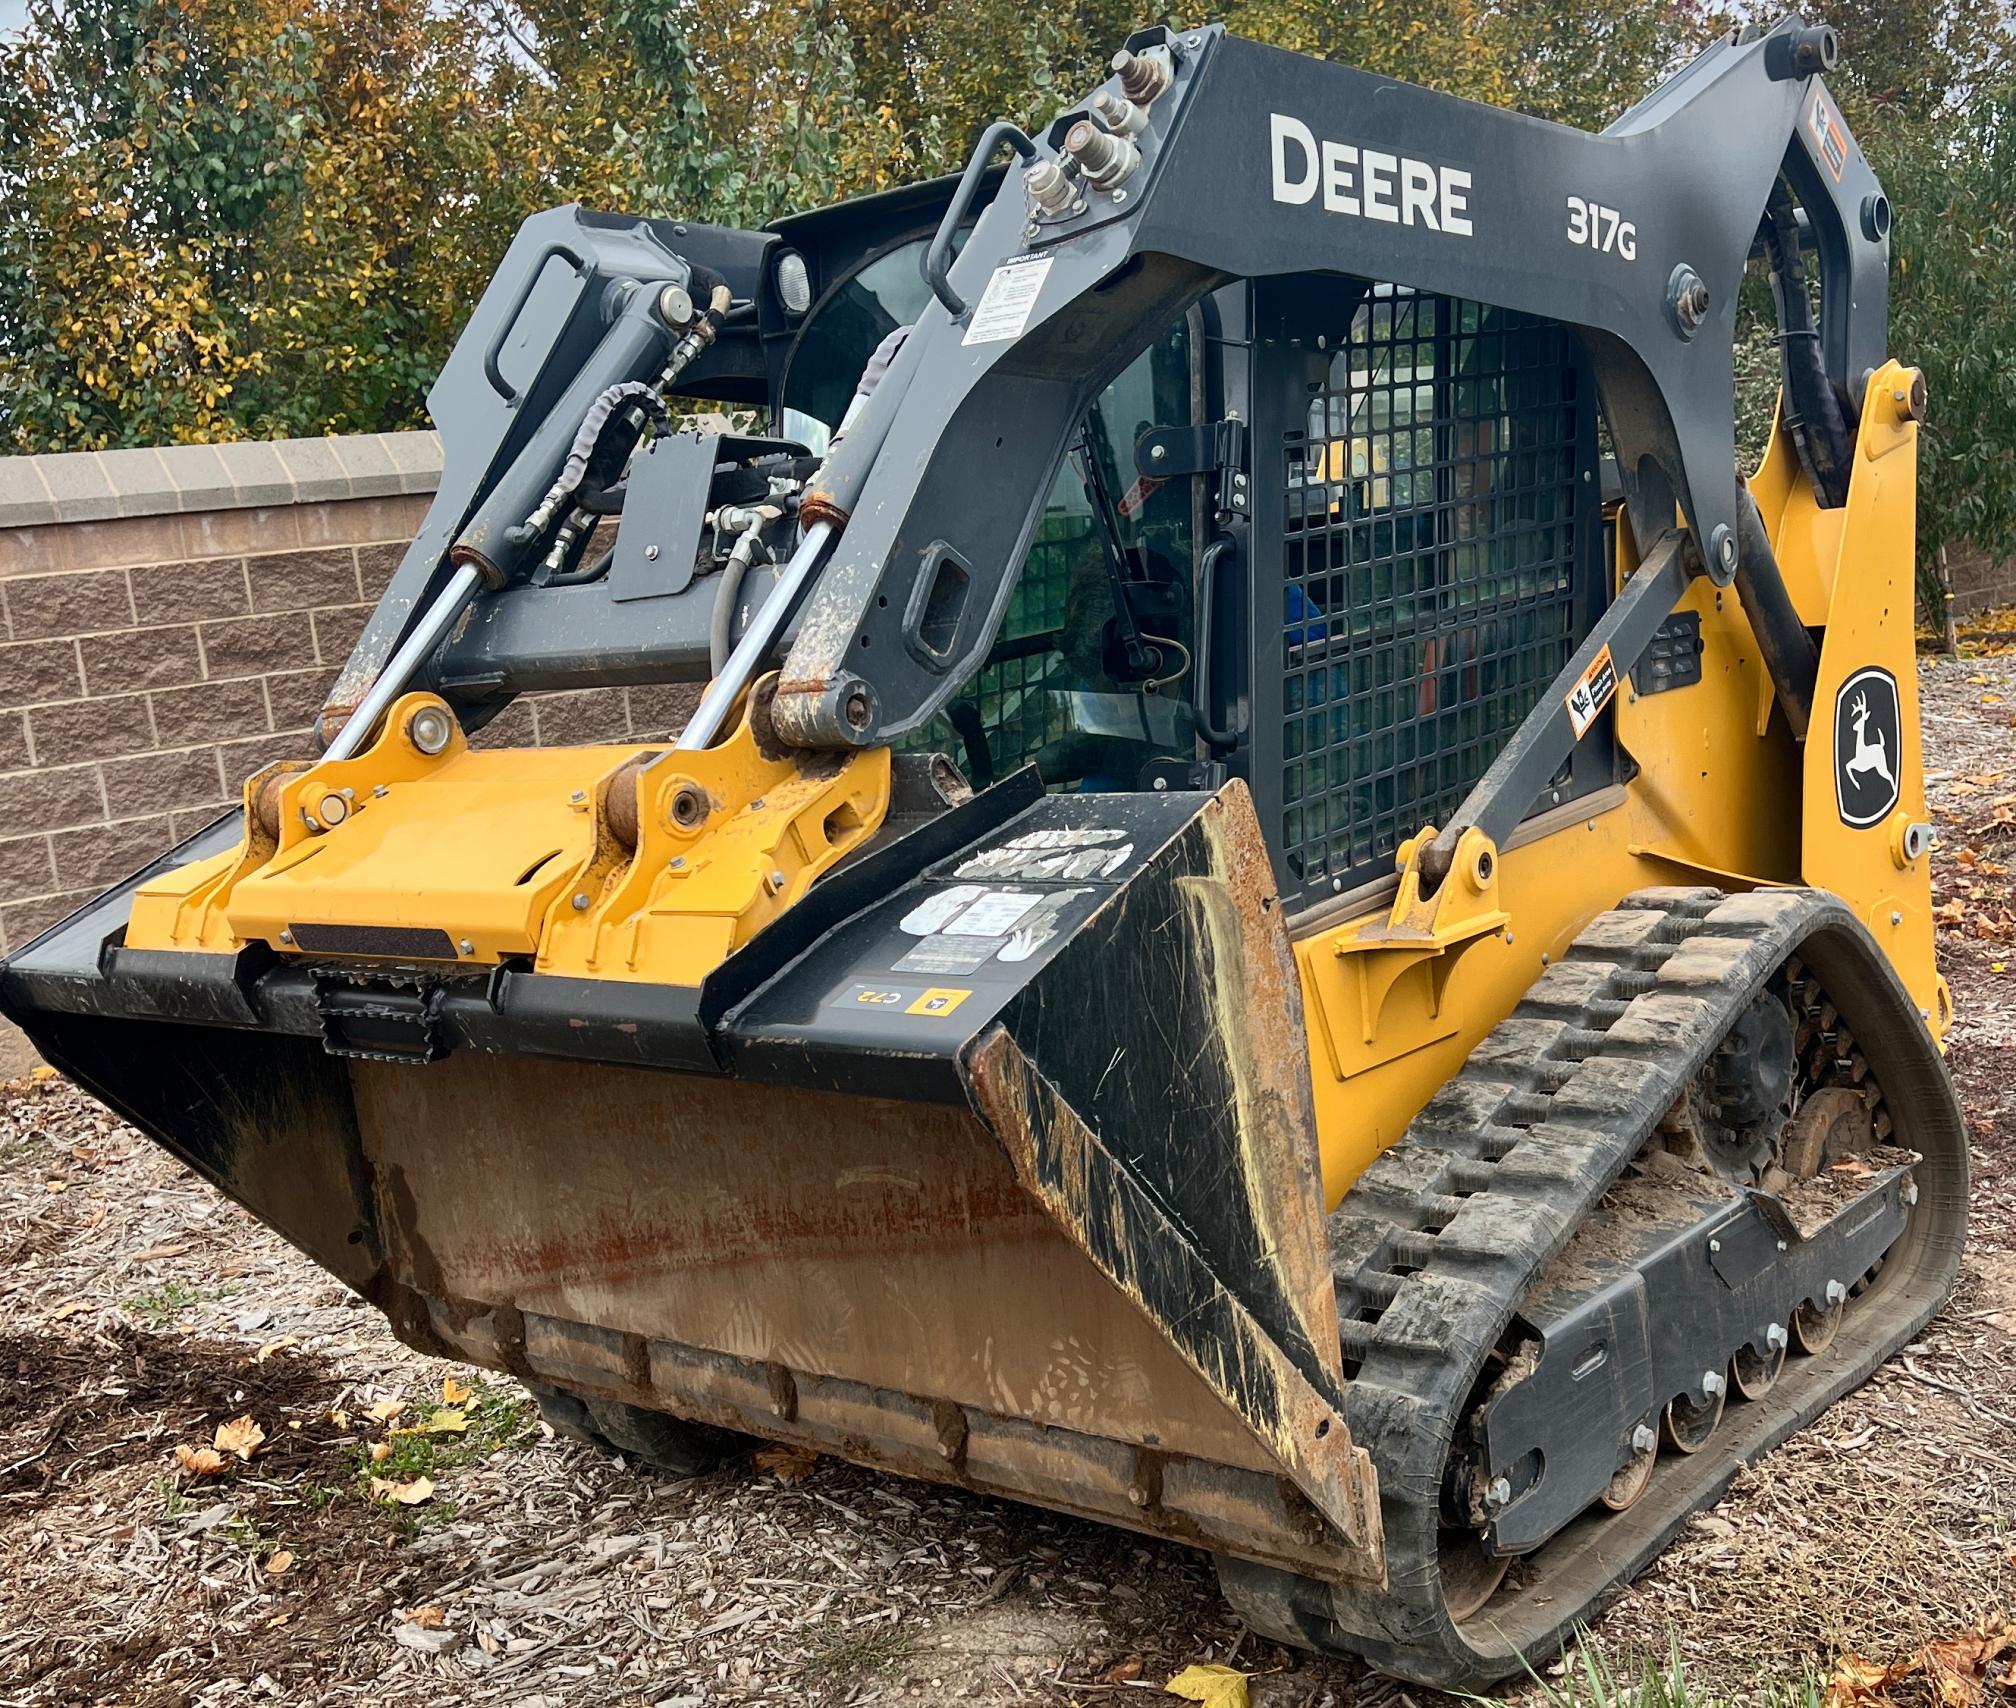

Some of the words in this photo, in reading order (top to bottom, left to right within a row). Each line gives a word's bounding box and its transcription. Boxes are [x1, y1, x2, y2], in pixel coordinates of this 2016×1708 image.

[1270, 113, 1473, 236] DEERE
[1567, 197, 1637, 260] 317G
[1007, 251, 1049, 264] IMPORTANT
[857, 991, 900, 1004] C72
